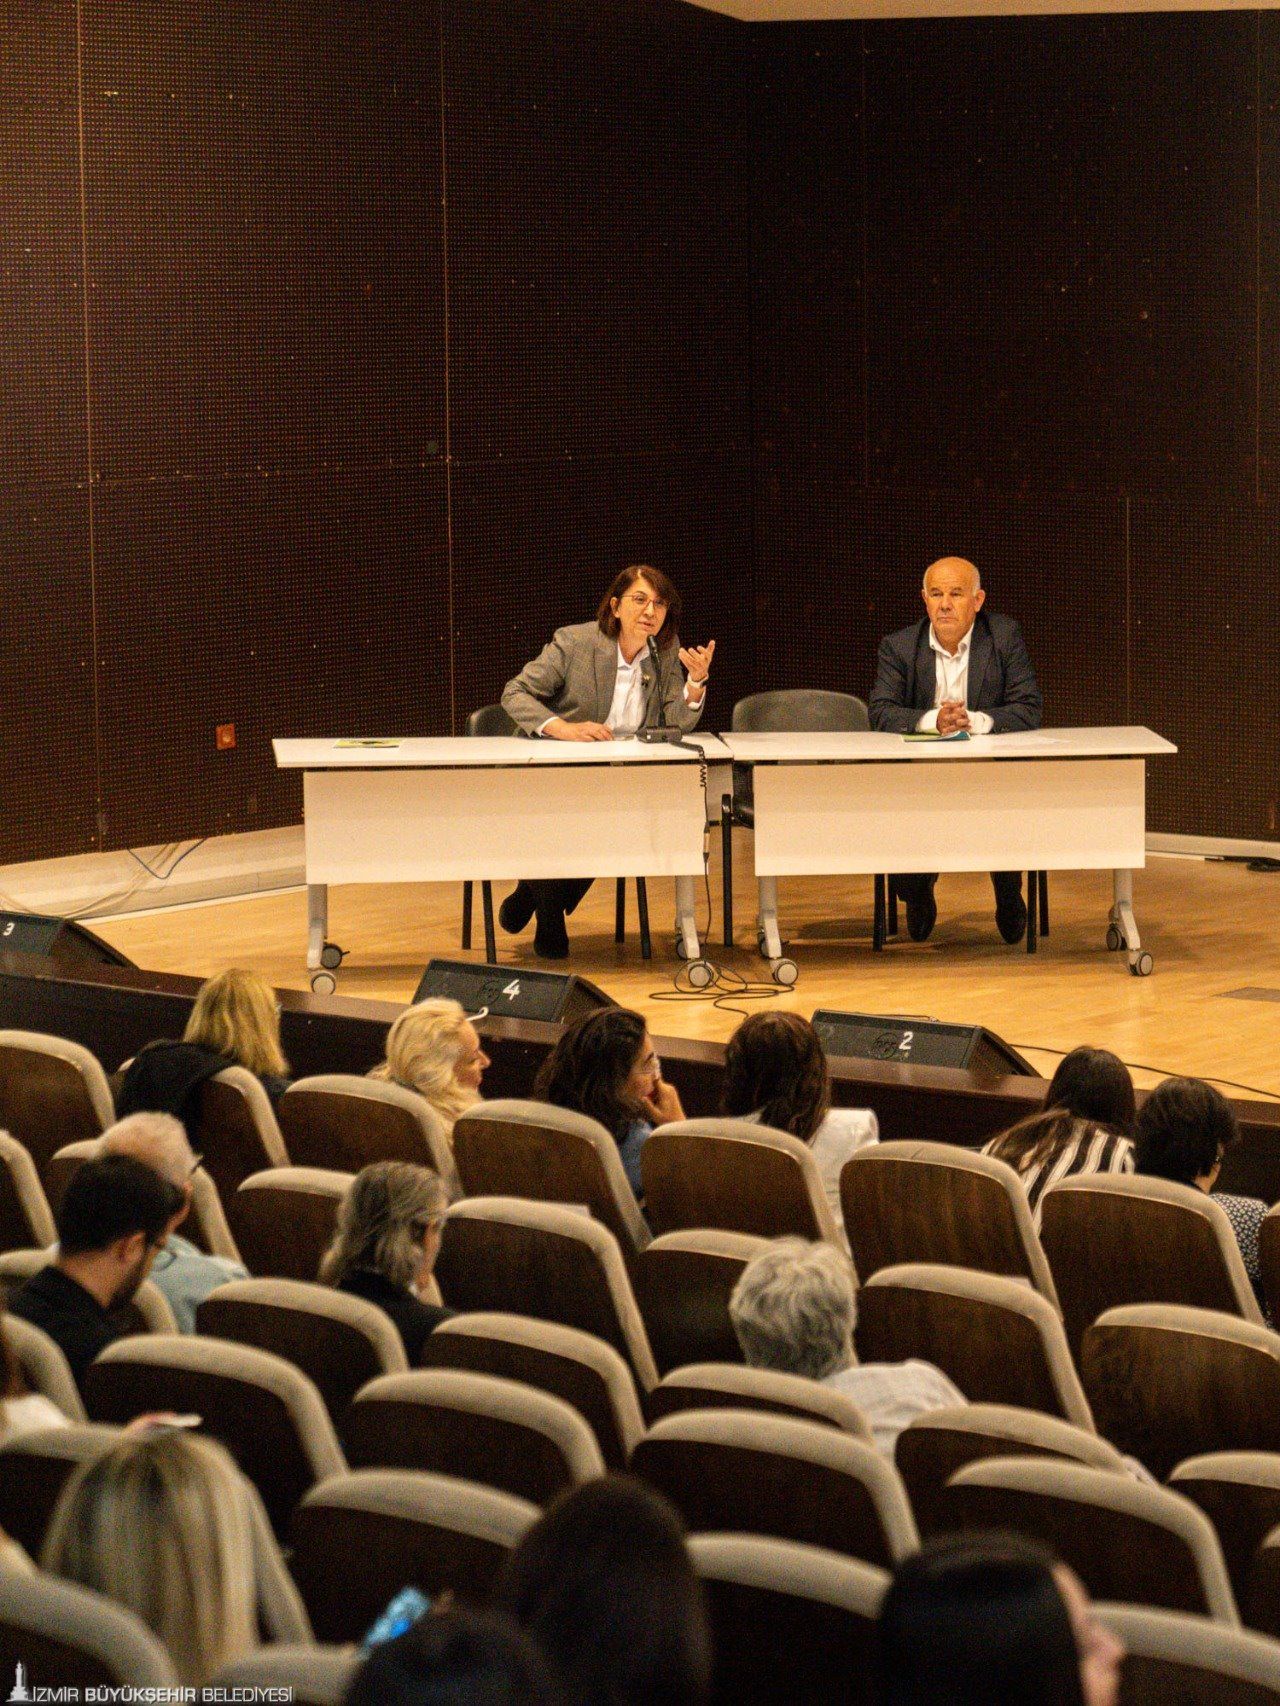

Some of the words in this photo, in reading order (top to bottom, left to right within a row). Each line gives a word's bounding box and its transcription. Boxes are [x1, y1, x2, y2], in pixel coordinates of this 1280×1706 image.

[3, 922, 15, 936] 3
[502, 978, 521, 1000] 4
[898, 1031, 914, 1050] 2
